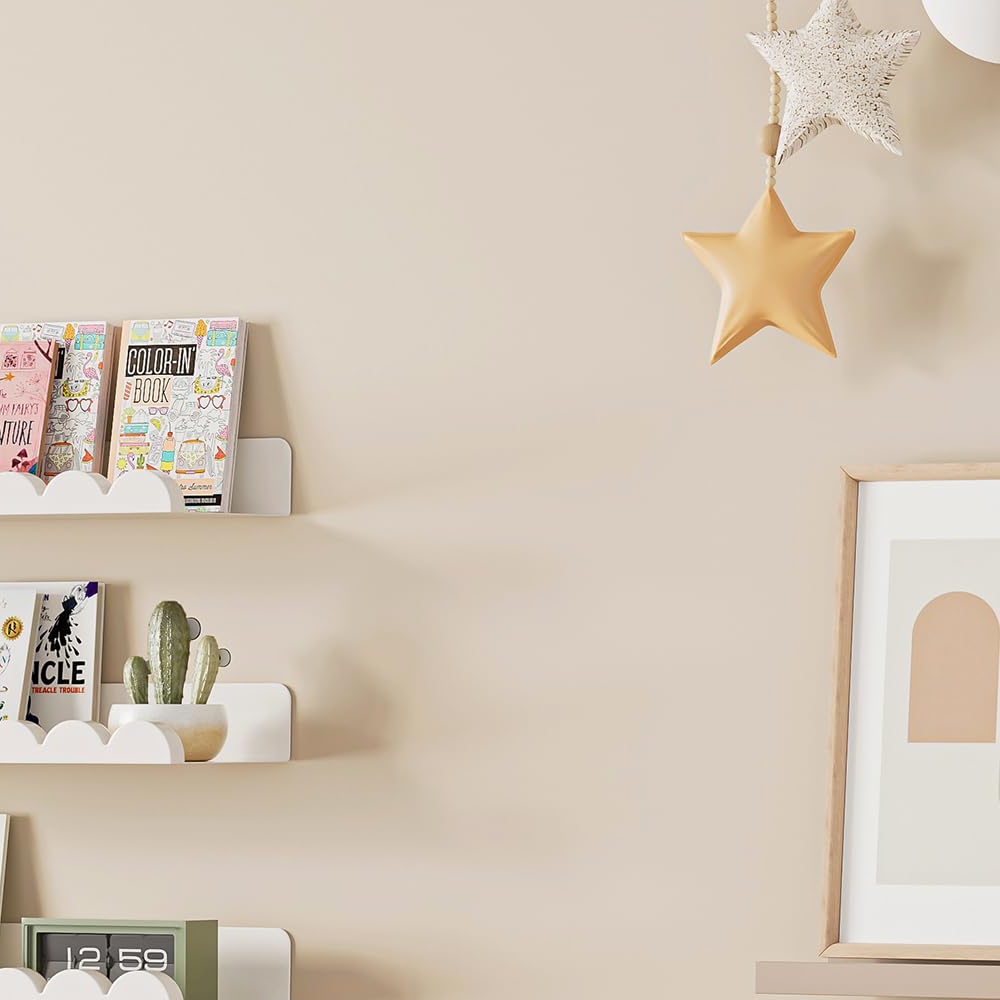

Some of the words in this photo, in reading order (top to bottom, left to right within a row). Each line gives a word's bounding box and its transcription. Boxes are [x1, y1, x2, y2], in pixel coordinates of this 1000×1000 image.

[133, 377, 171, 404] BOOK
[60, 686, 86, 694] TROUBLE
[67, 947, 101, 971] 12
[118, 948, 168, 972] 59
